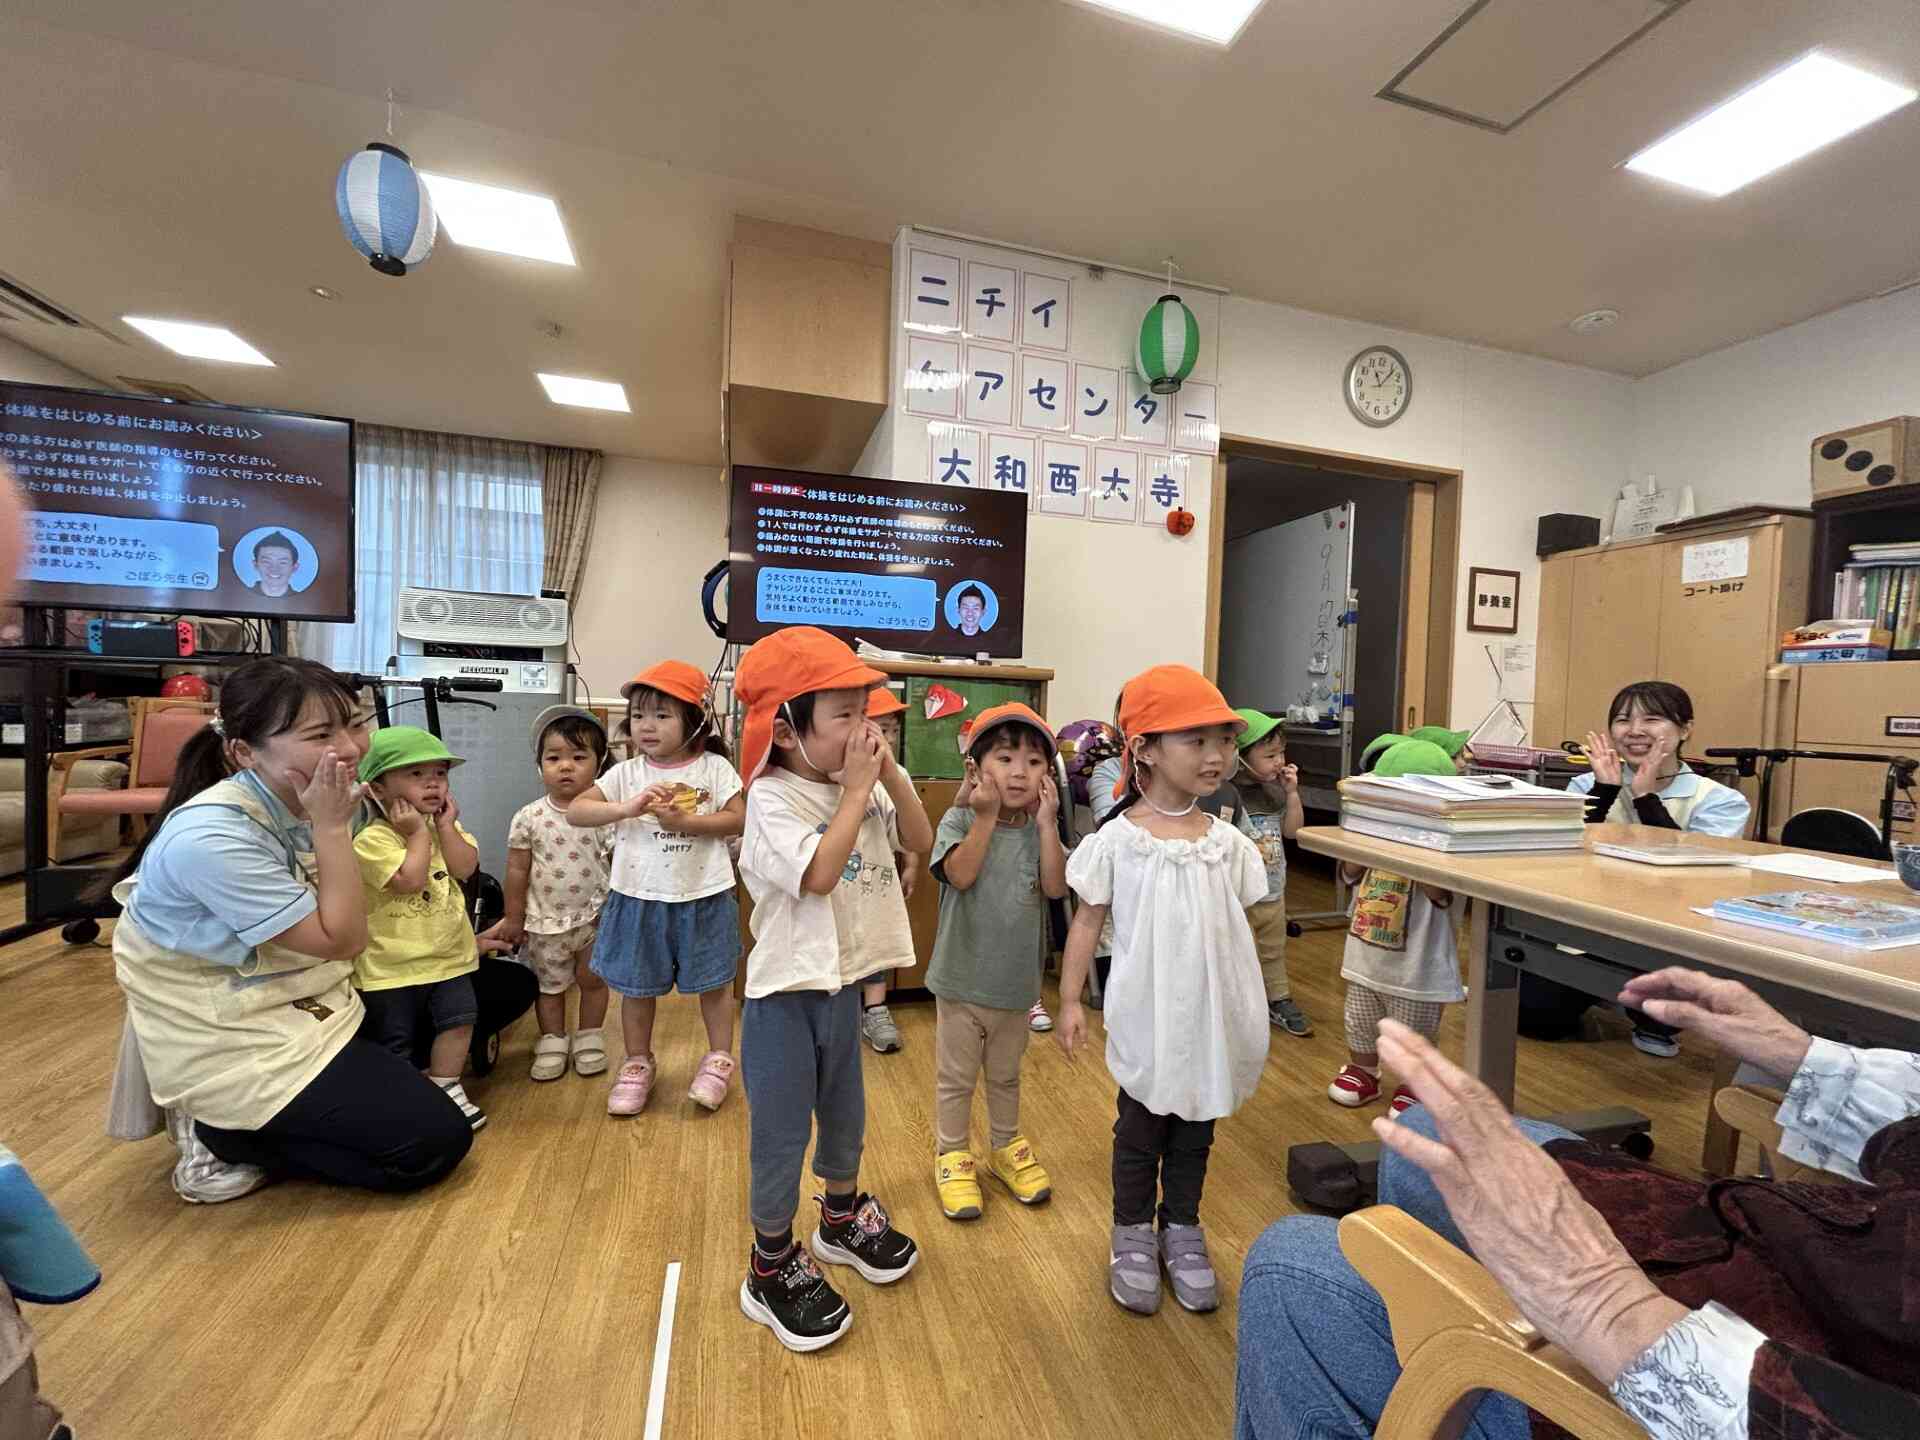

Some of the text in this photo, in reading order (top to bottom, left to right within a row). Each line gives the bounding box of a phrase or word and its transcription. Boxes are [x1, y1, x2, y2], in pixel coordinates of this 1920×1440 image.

[917, 276, 1057, 328] ニチイ
[938, 448, 1180, 507] 大和西大寺
[653, 831, 676, 840] Tom
[662, 843, 692, 853] Jerry
